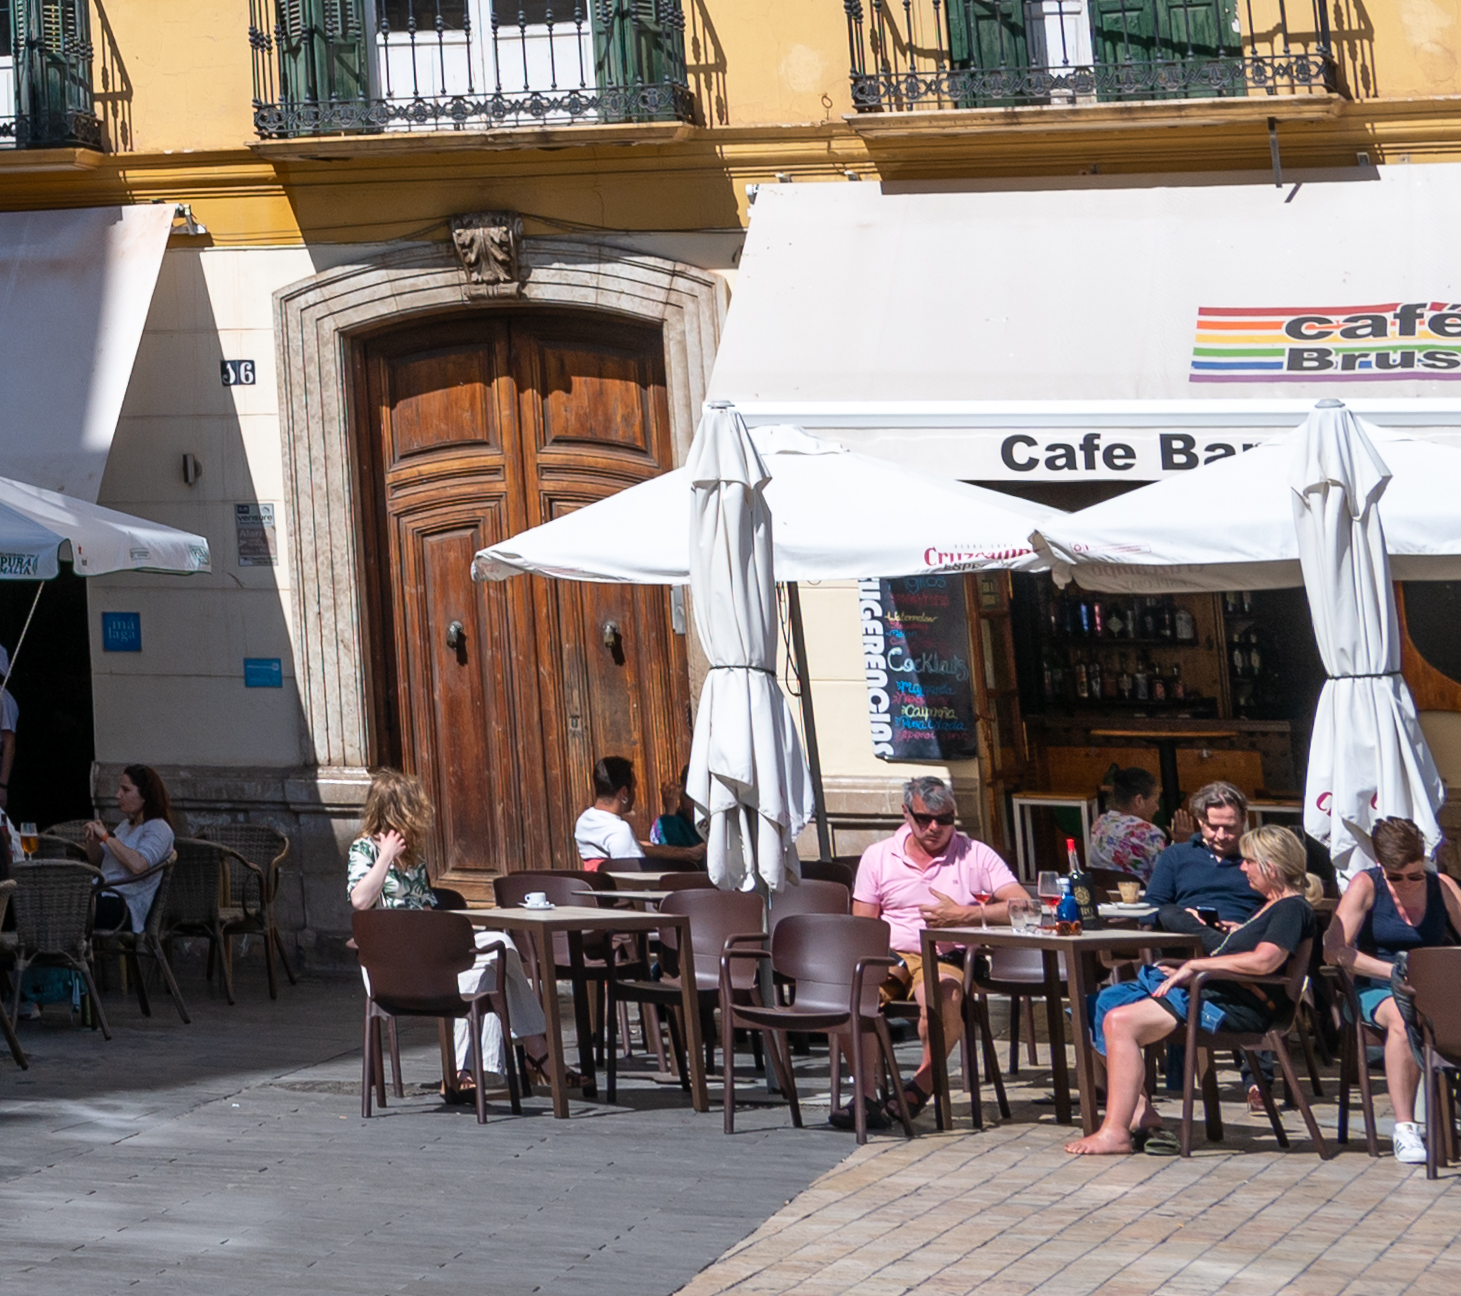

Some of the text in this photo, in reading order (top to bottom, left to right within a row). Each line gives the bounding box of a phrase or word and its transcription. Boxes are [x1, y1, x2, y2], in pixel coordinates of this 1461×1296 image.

[221, 361, 254, 385] 16
[1000, 432, 1137, 473] Cafe
[237, 514, 273, 522] verisure
[0, 556, 31, 567] PURA
